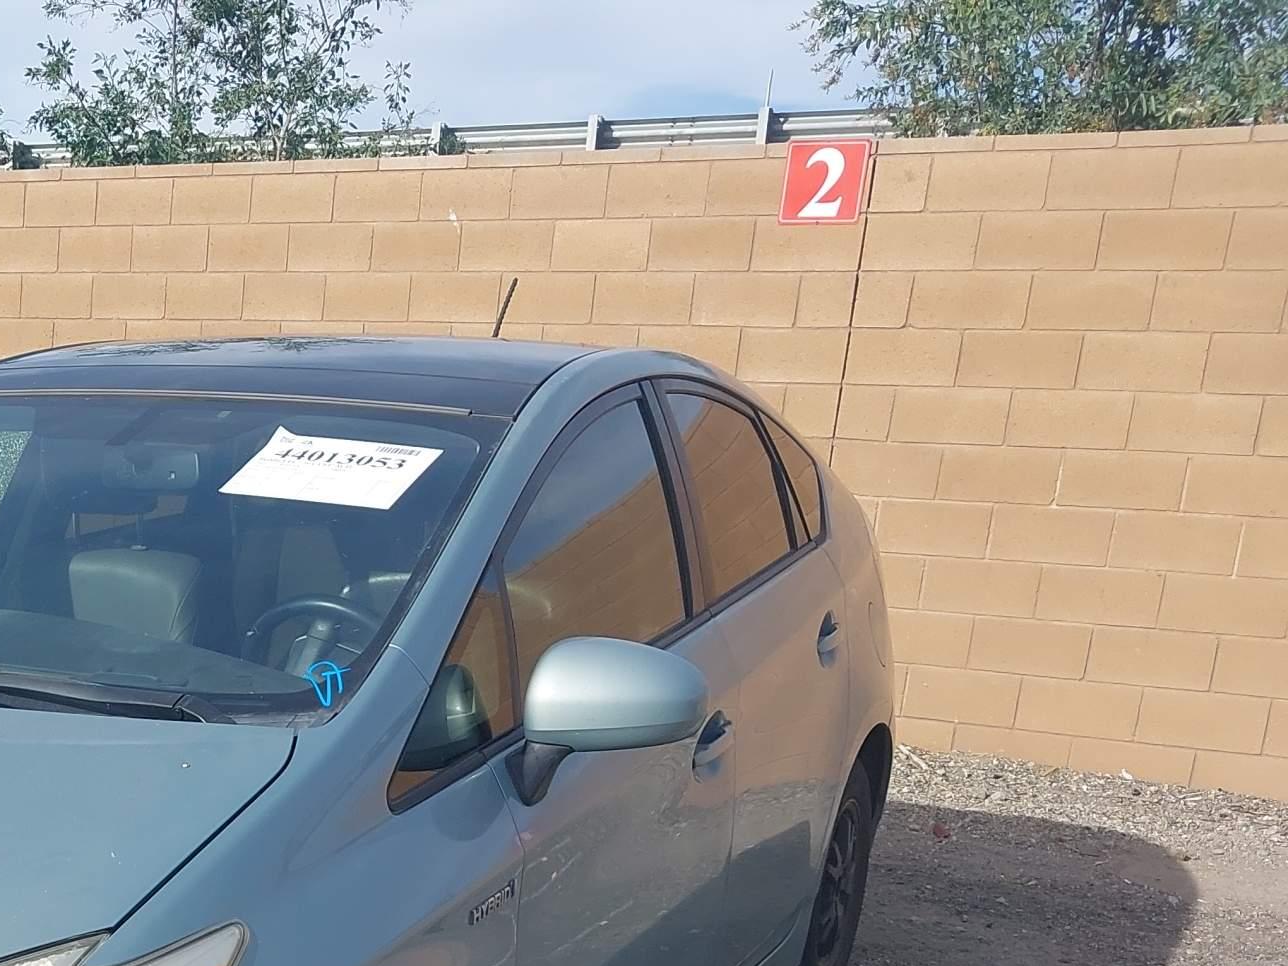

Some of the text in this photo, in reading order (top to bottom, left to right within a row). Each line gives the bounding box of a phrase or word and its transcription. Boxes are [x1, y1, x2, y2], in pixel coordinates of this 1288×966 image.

[796, 146, 846, 218] 2
[275, 447, 407, 470] 44013053
[472, 882, 514, 926] HYBRID
